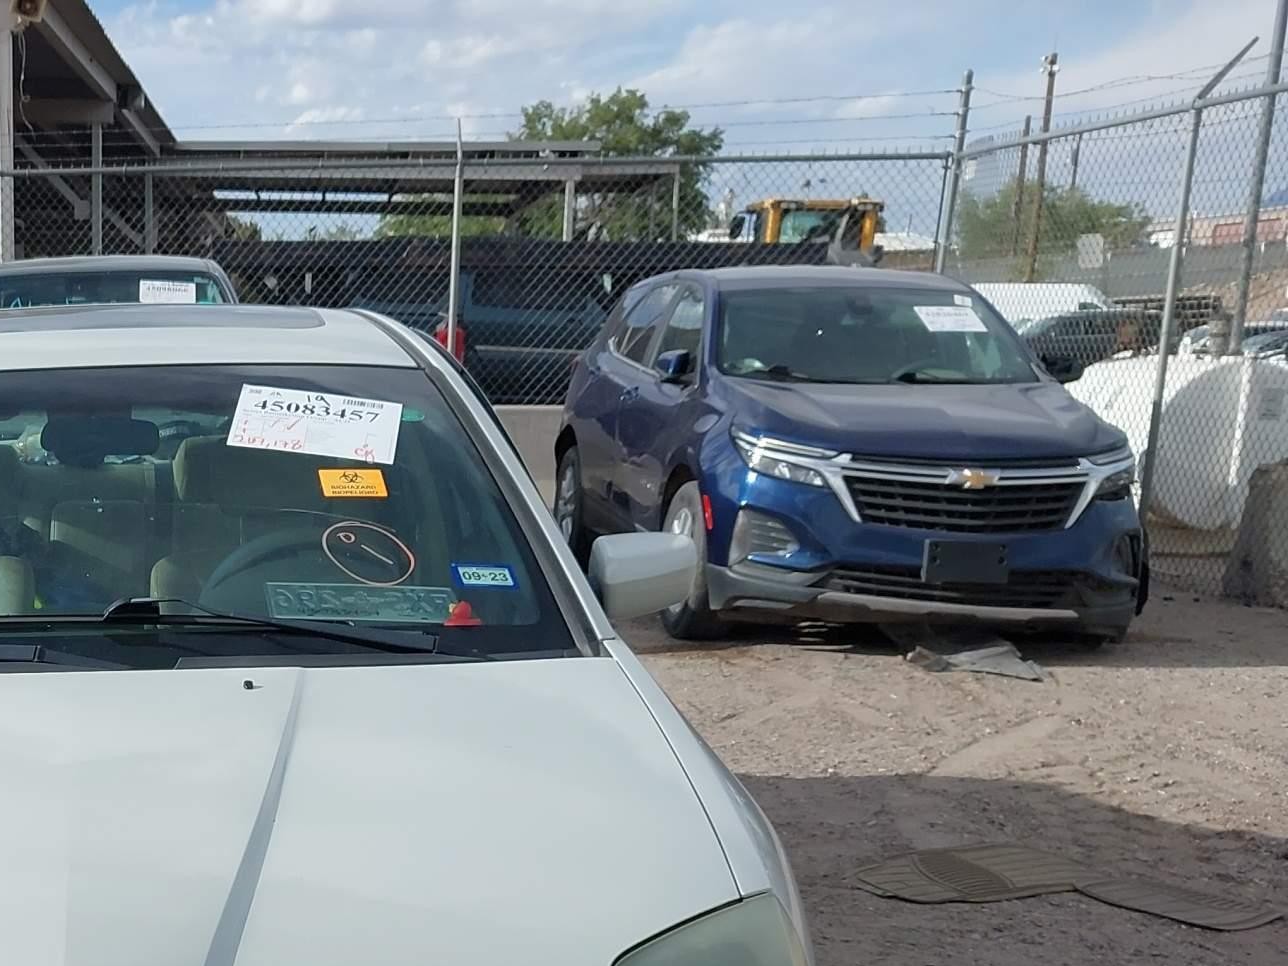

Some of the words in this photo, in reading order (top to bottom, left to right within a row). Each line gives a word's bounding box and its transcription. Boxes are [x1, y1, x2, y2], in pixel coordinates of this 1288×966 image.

[254, 399, 380, 423] 45083457
[463, 571, 481, 581] 09
[489, 572, 508, 582] 23
